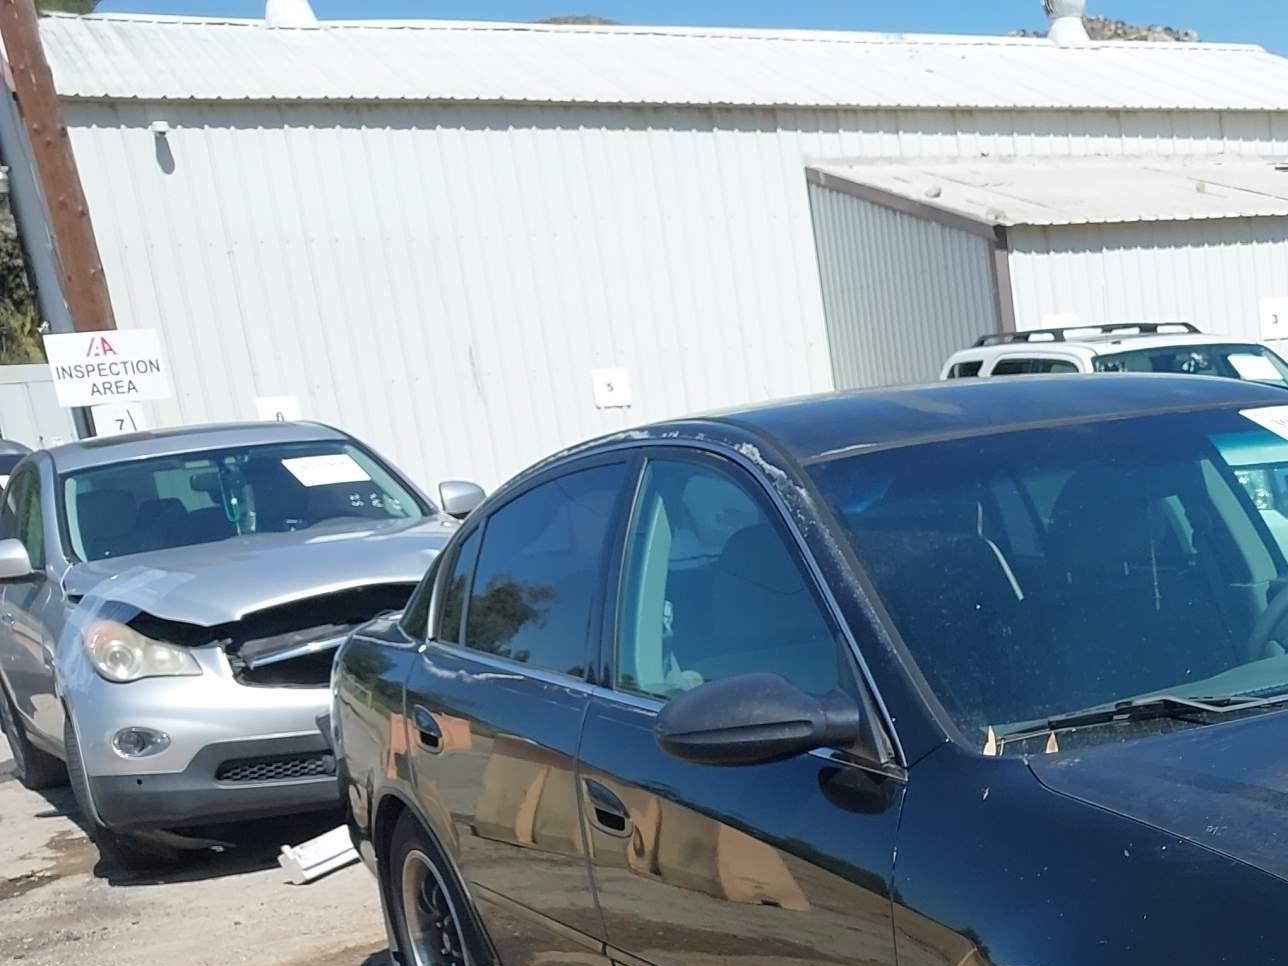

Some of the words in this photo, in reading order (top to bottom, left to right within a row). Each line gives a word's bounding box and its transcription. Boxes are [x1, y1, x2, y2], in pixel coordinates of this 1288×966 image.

[1271, 313, 1279, 324] 3
[55, 358, 161, 380] INSPECTION
[90, 379, 139, 397] AREA
[114, 418, 125, 431] 7
